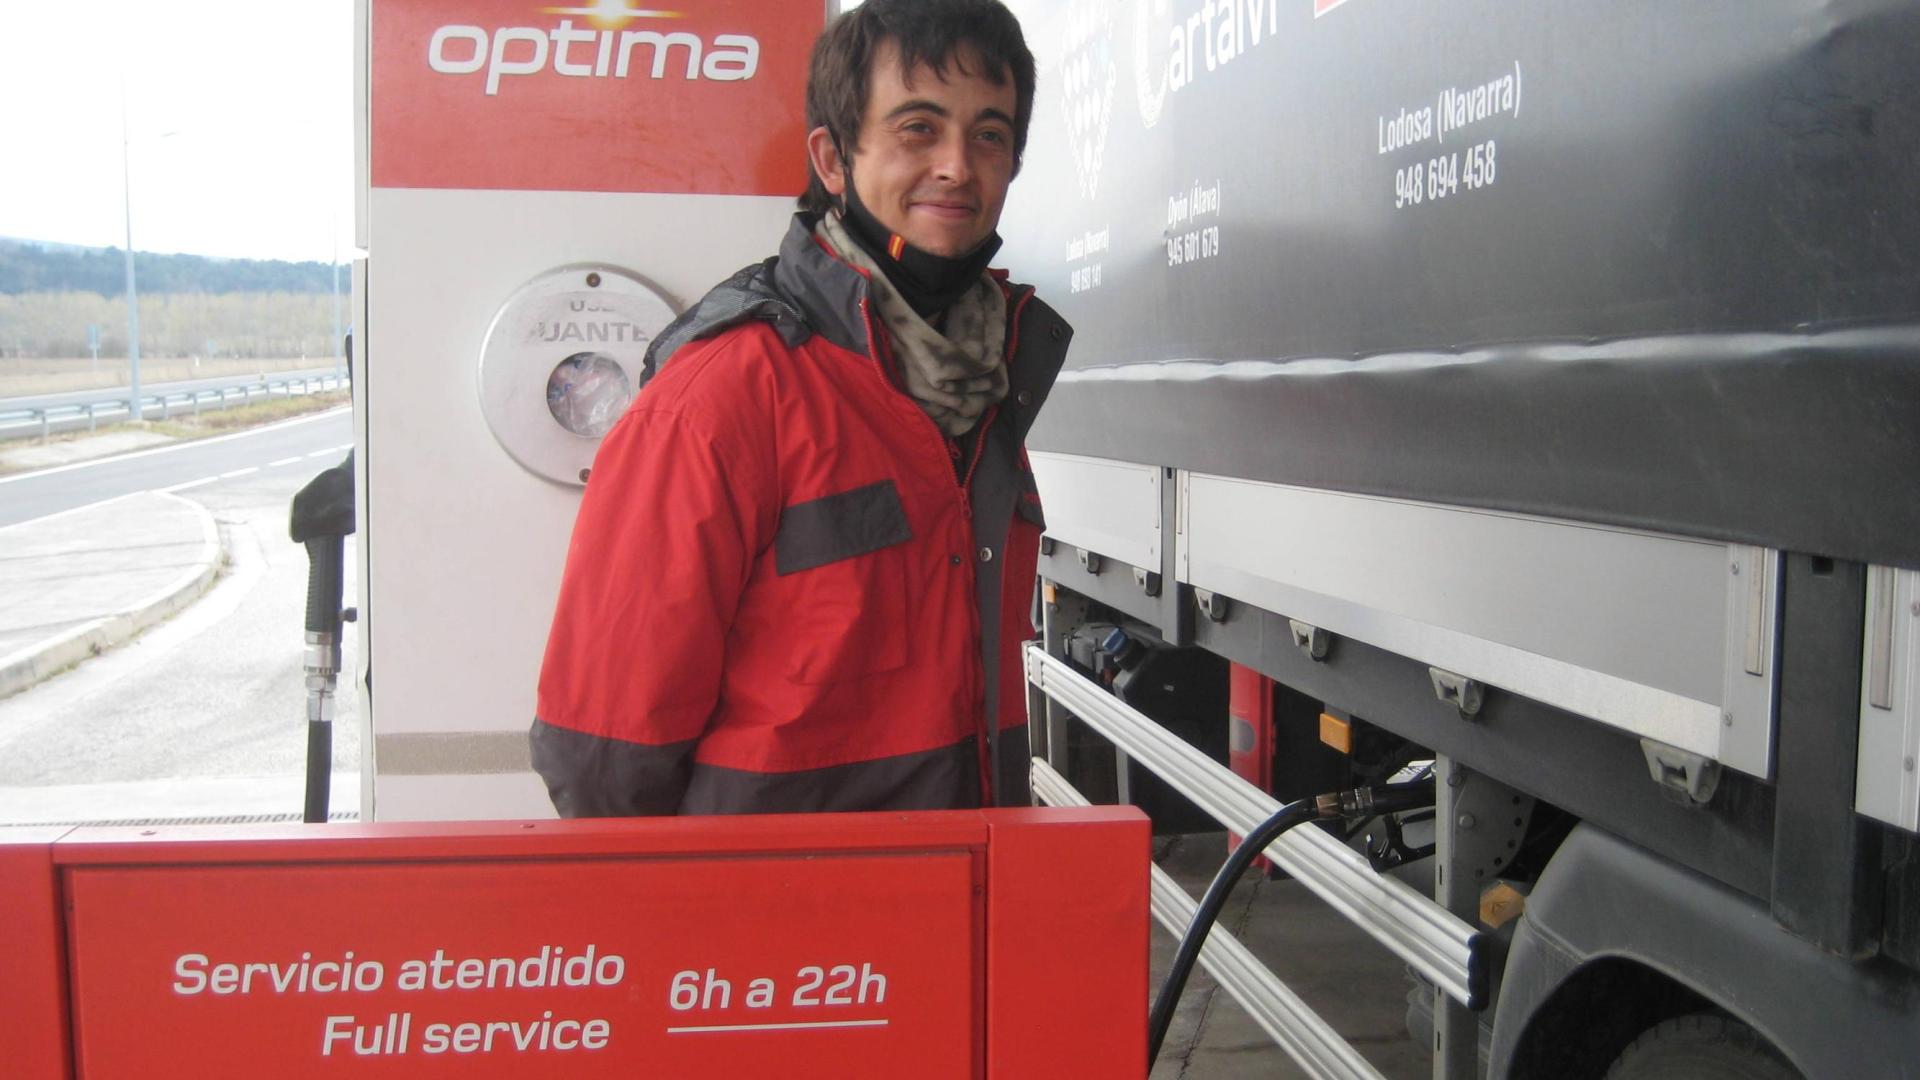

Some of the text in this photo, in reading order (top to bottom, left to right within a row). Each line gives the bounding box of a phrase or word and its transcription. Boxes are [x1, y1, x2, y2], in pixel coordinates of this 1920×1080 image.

[428, 20, 761, 95] optima
[1378, 60, 1521, 154] Lodosa (Navarra)
[1395, 140, 1496, 209] 948 694 458
[1189, 178, 1221, 223] (Álava)
[1167, 226, 1219, 267] 945 601 679
[173, 944, 625, 995] Servicio atendido
[669, 962, 887, 1011] 6h a 22h
[322, 1010, 610, 1056] Full service
